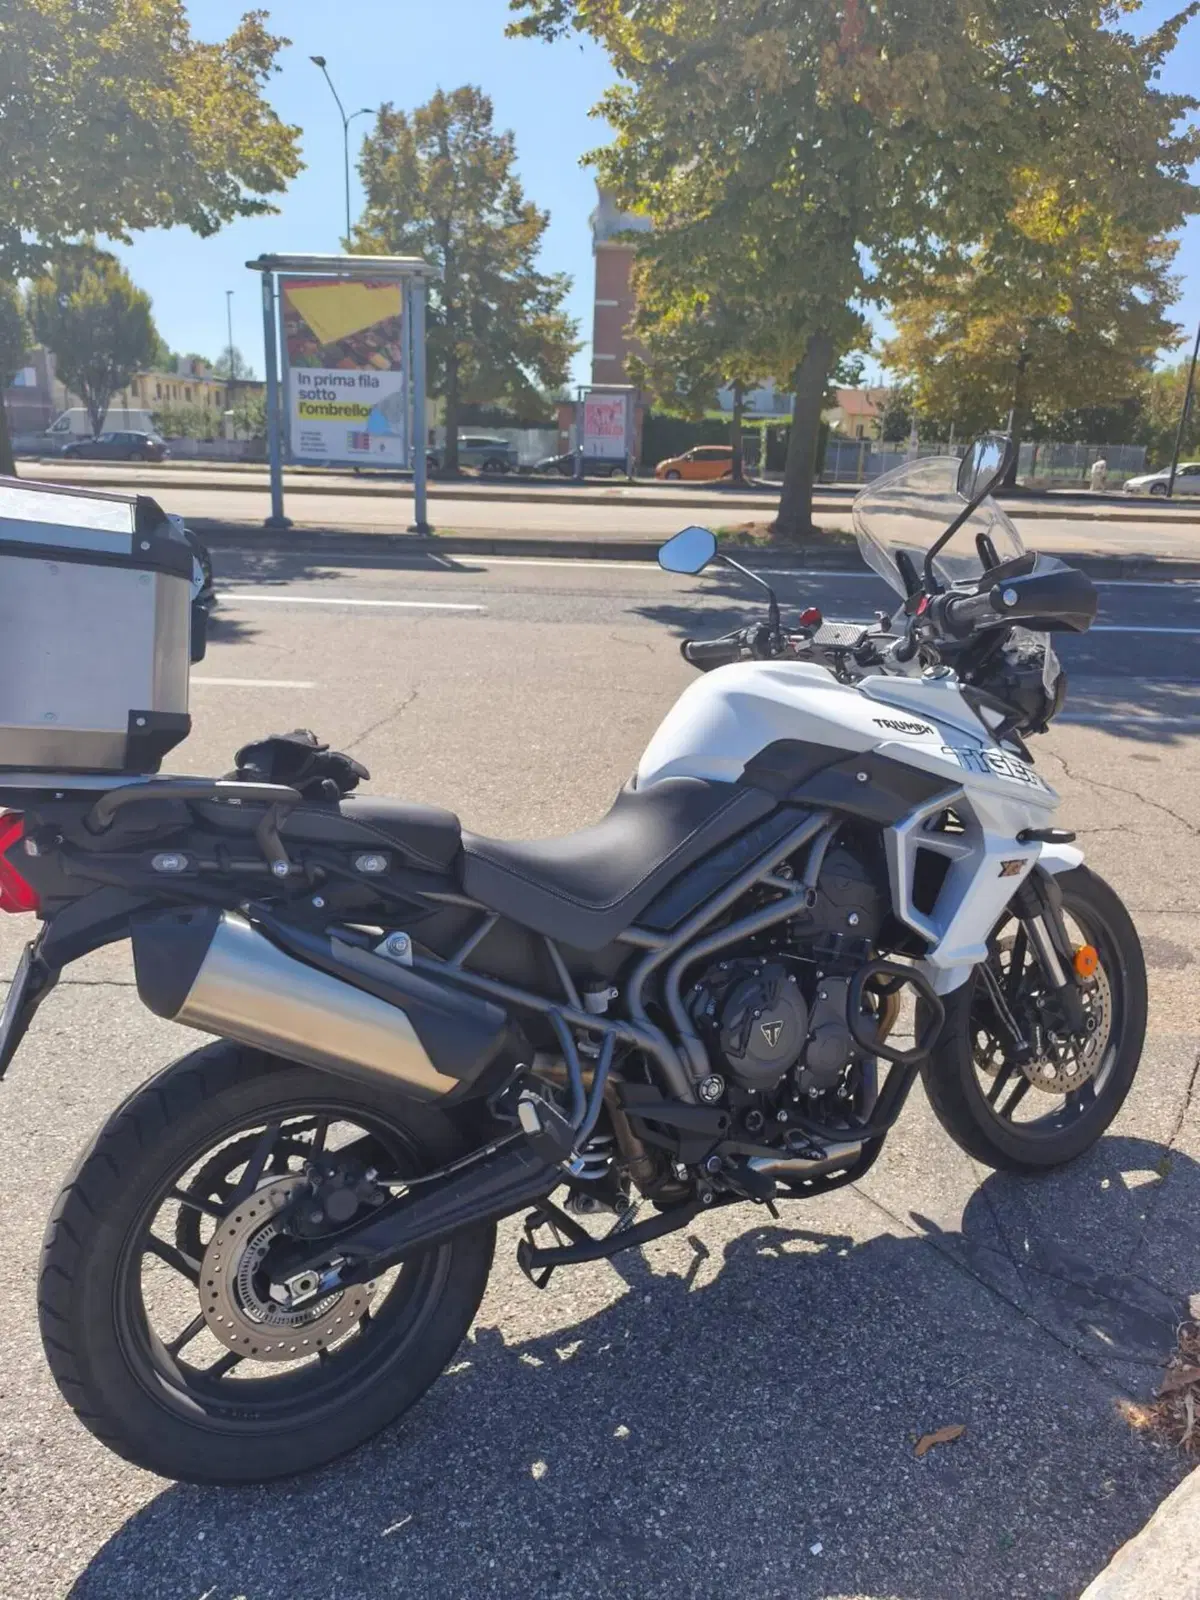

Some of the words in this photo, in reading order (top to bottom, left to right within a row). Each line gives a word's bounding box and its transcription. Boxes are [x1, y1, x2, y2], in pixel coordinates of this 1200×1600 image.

[298, 373, 311, 385] In
[314, 373, 355, 388] prima
[358, 374, 380, 389] fila
[298, 388, 337, 401] sotto
[872, 718, 935, 736] TRIUMPH
